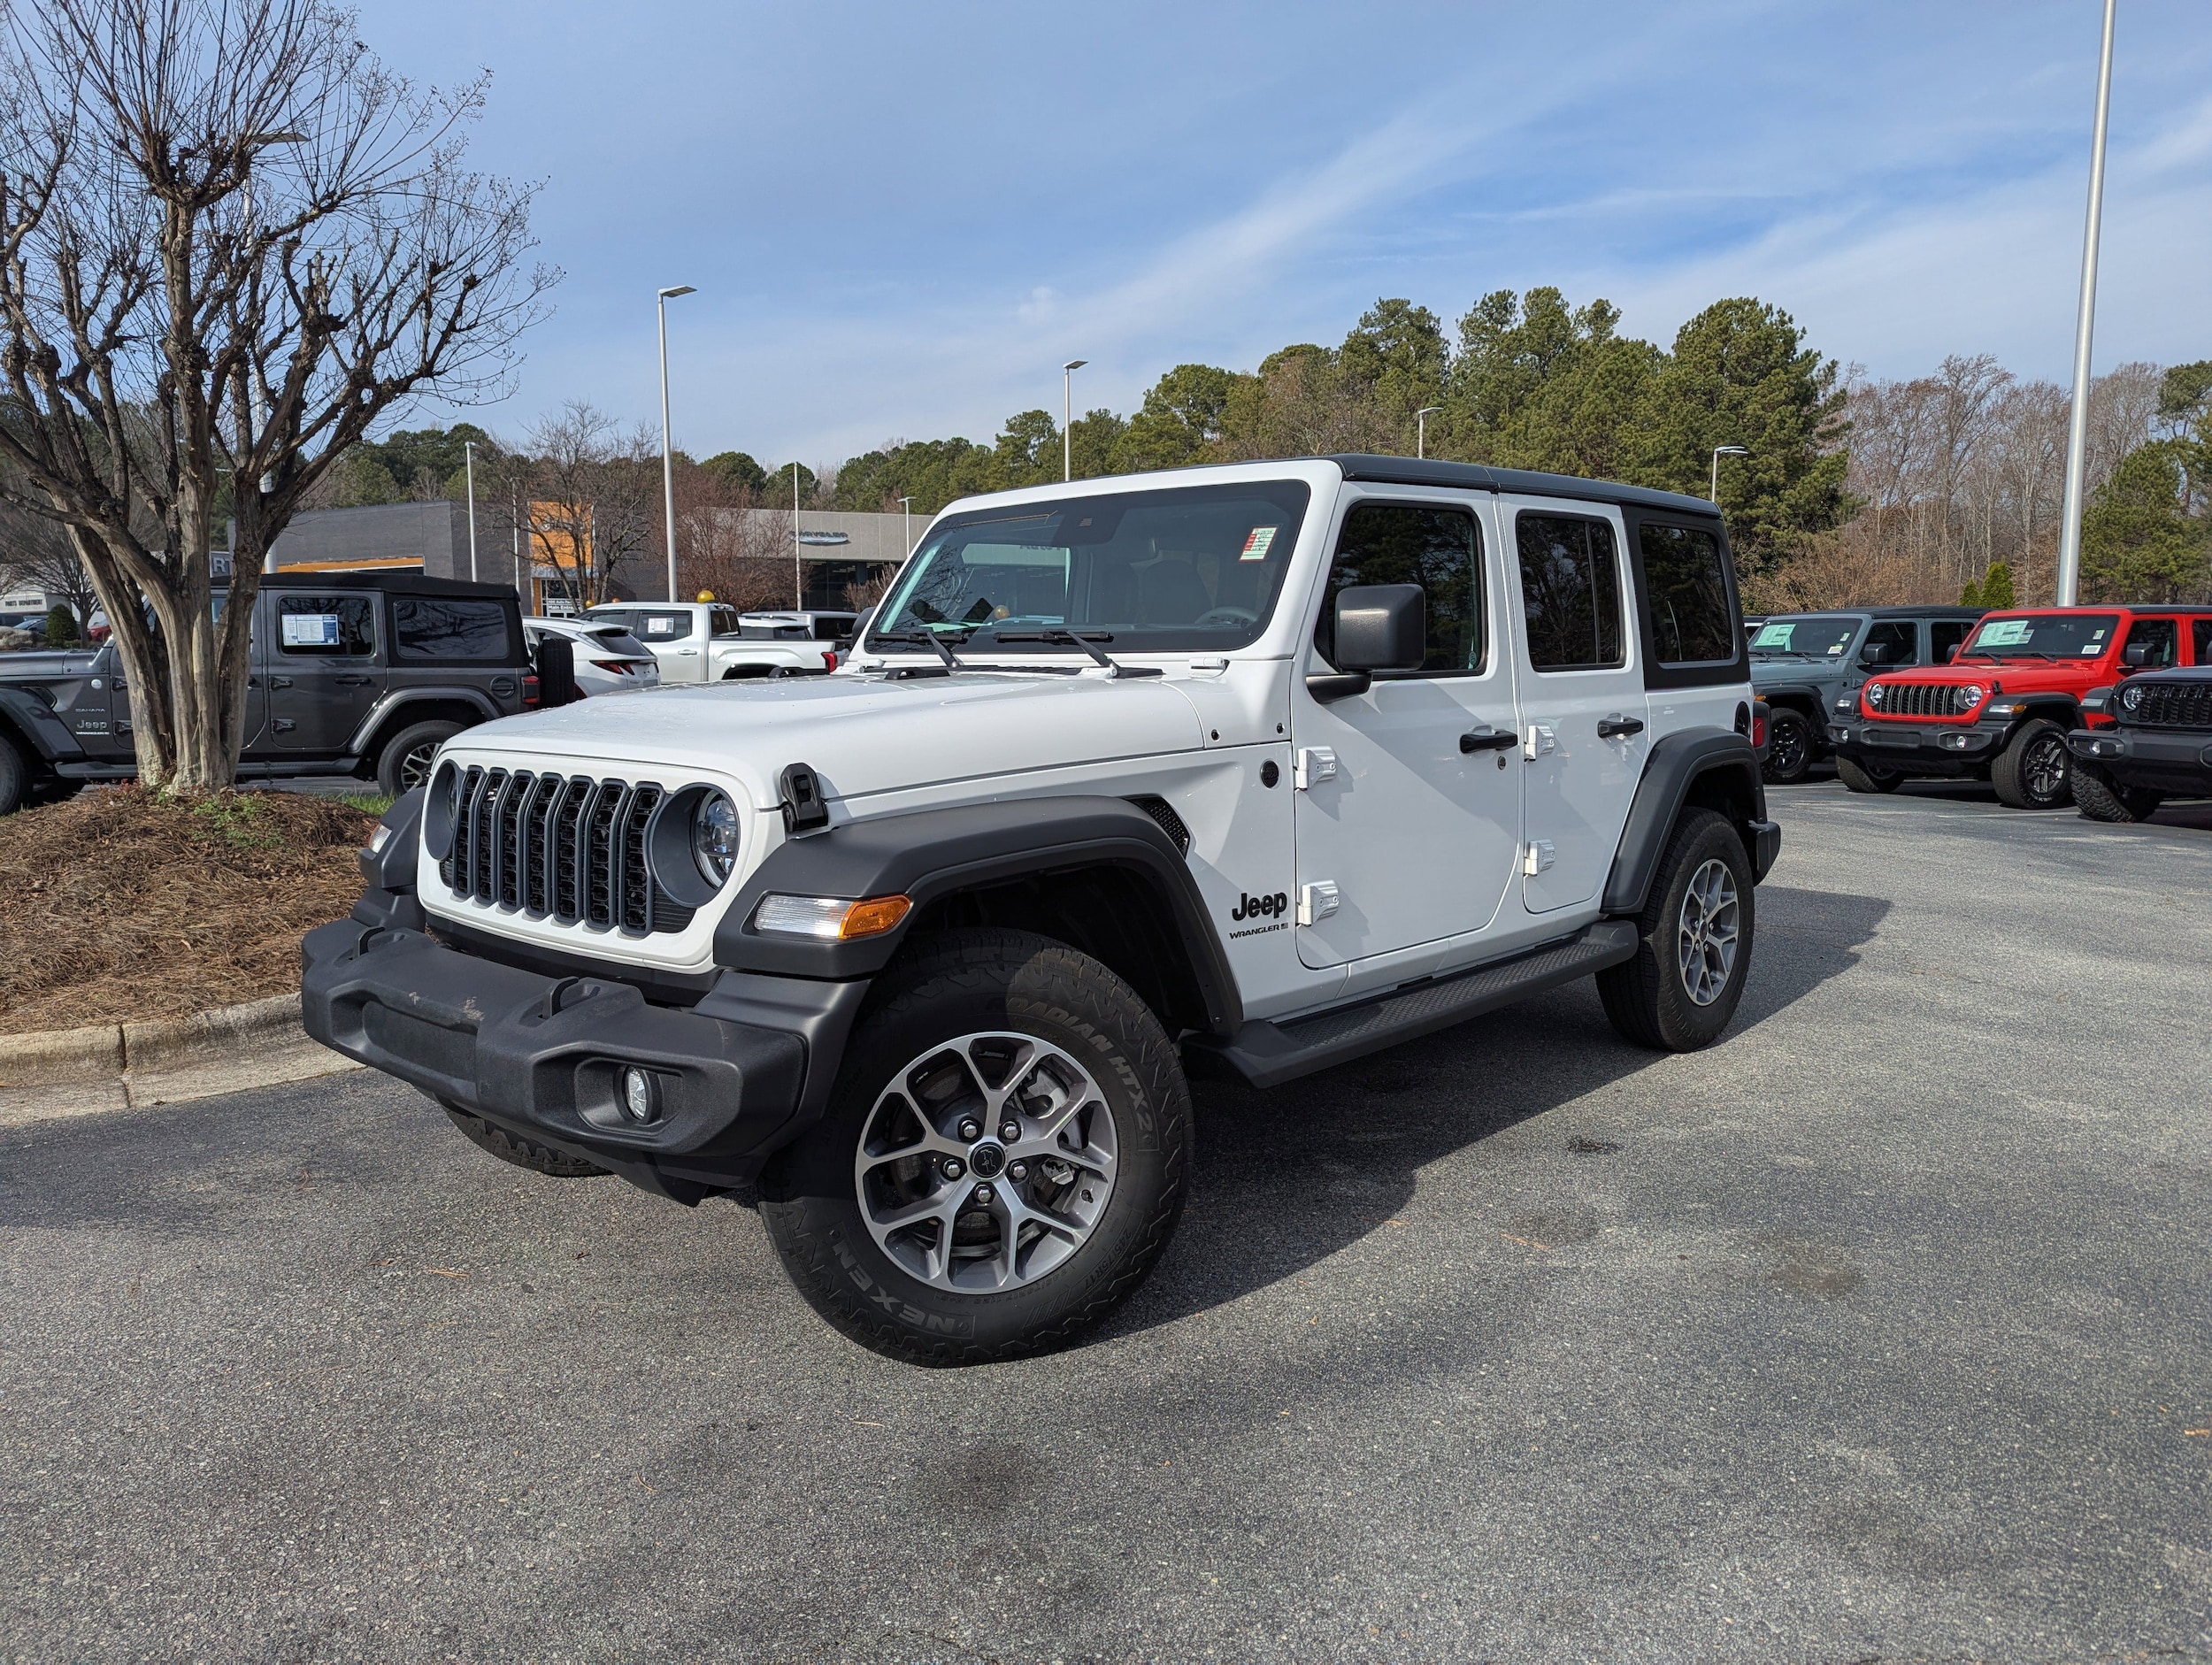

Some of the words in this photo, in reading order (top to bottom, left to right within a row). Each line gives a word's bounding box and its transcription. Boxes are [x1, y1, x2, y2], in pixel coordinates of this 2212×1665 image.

[76, 719, 108, 730] Jeep
[1232, 892, 1287, 921] Jeep
[1229, 925, 1279, 940] WRANGLER
[833, 1240, 956, 1332] NEXEN
